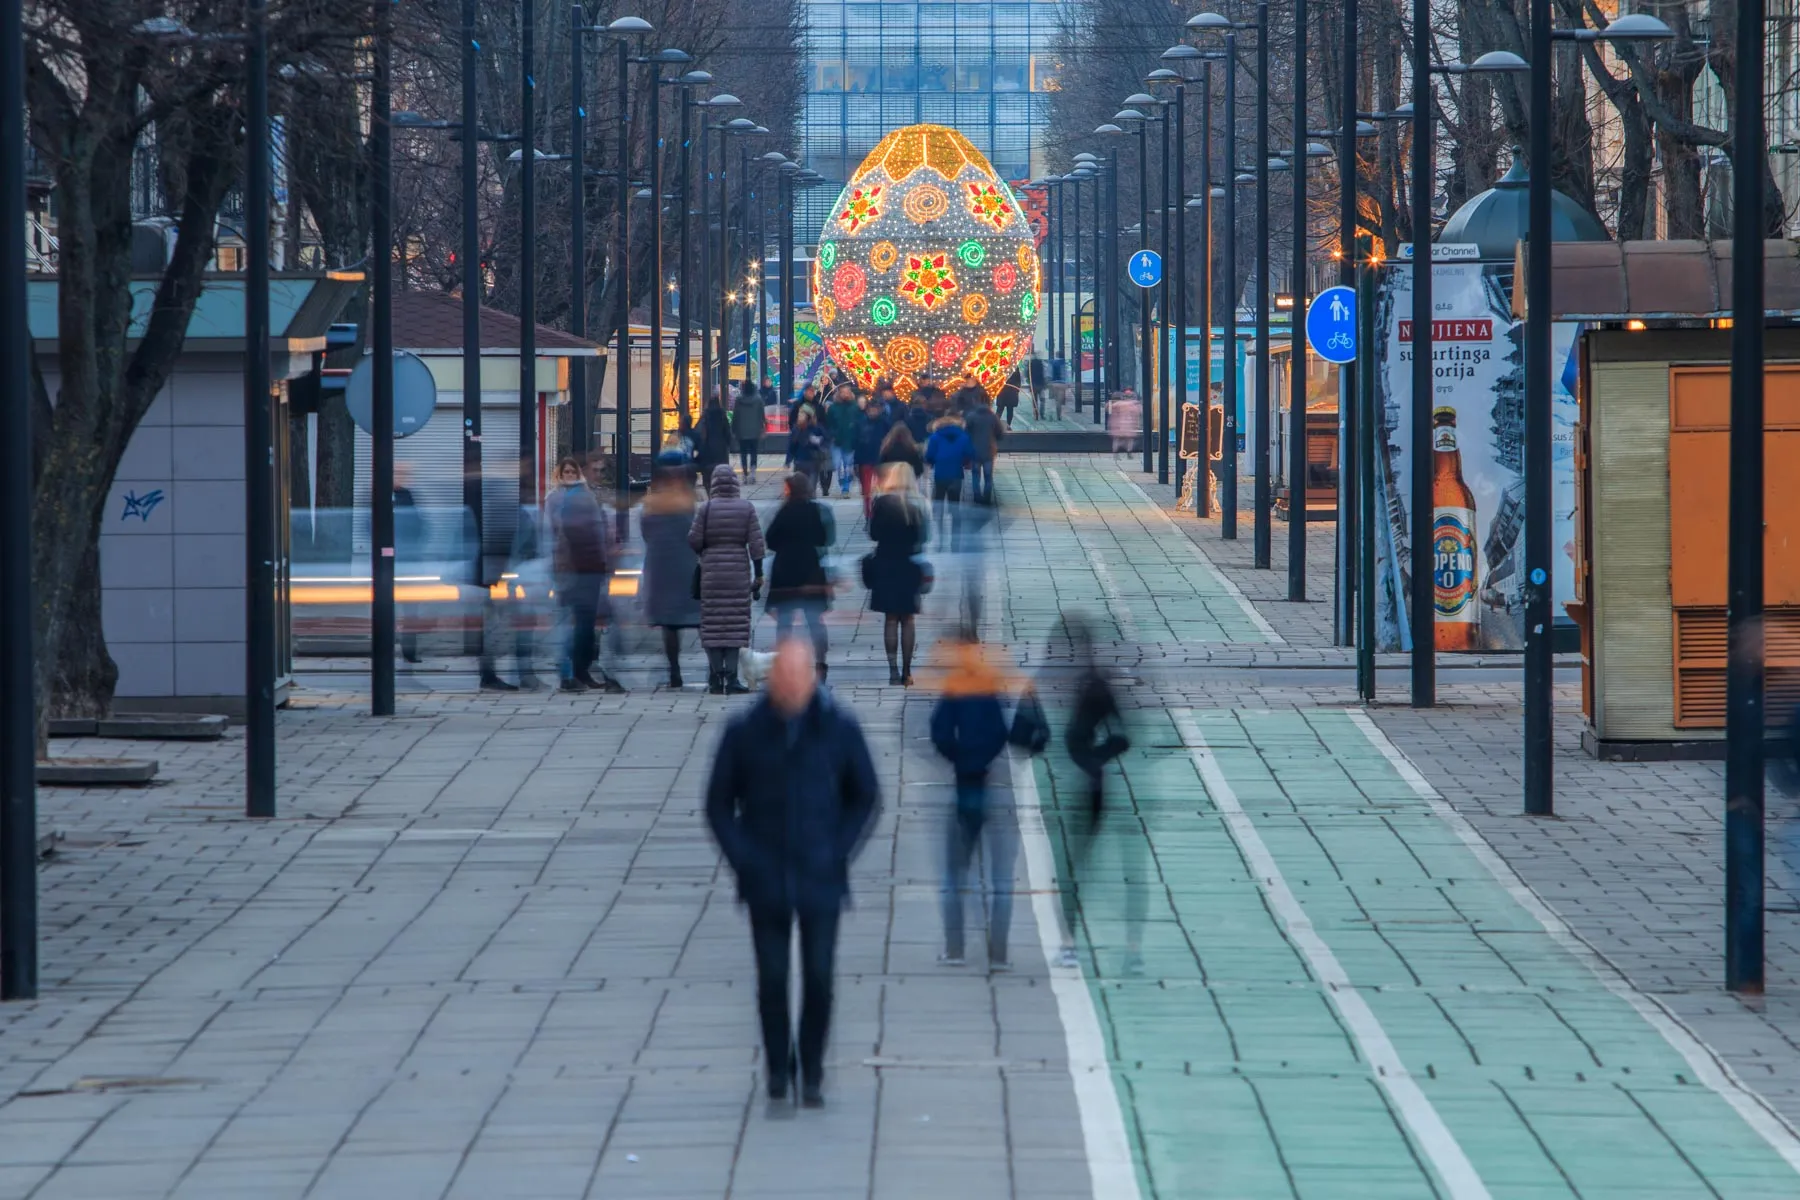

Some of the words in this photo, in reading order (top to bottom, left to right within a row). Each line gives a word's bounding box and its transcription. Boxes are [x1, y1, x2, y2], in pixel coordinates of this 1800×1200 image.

[1441, 246, 1476, 256] Channel
[1402, 323, 1489, 340] NJIENA
[1435, 363, 1475, 381] orija
